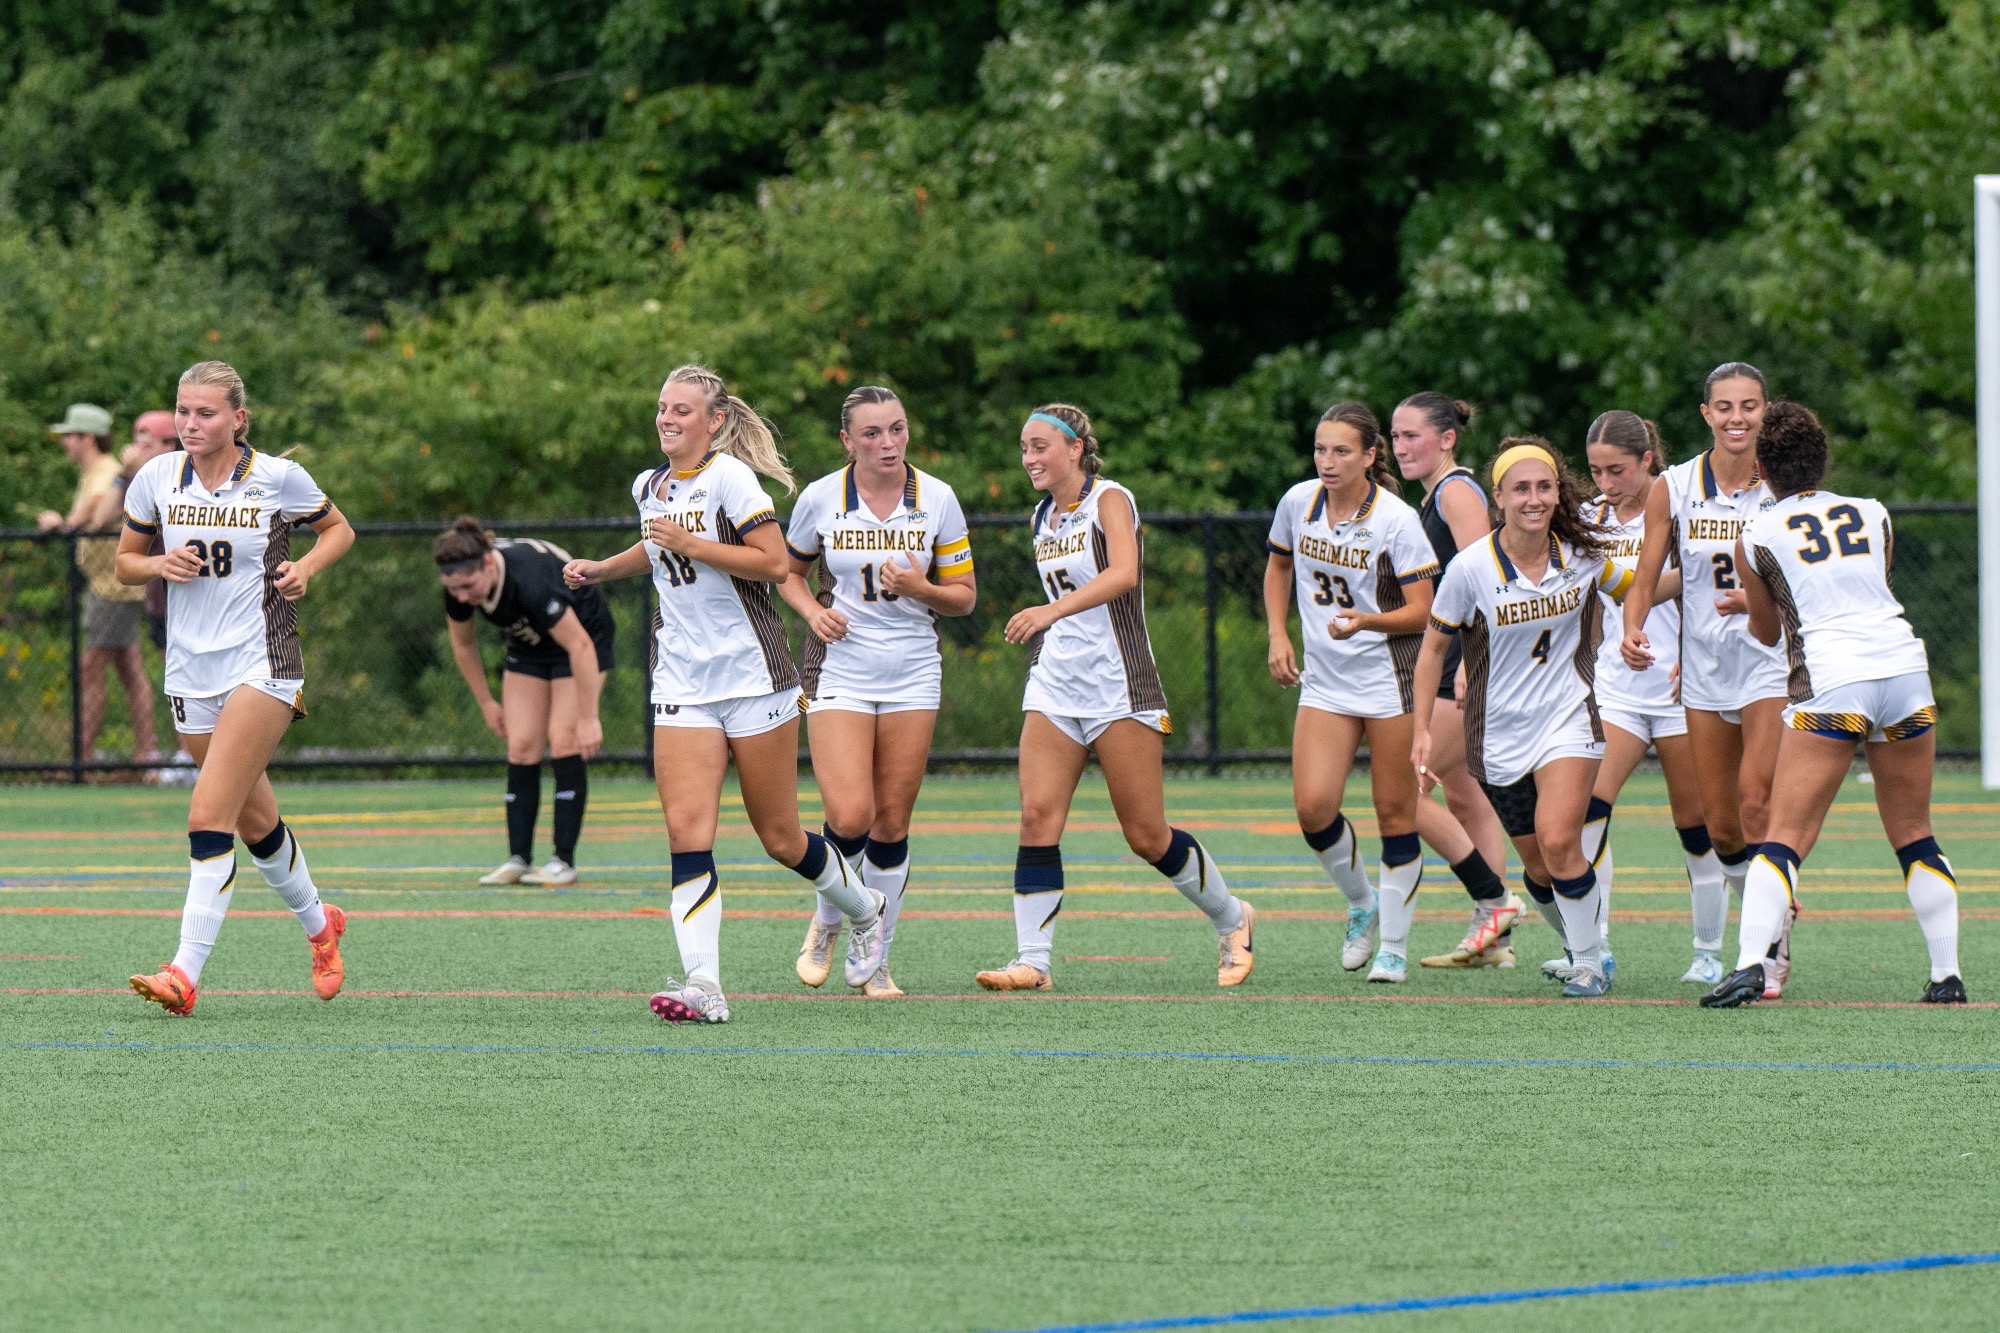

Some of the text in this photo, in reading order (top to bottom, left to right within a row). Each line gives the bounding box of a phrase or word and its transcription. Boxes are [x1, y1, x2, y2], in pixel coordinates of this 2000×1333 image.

[244, 489, 265, 499] MAAC
[689, 490, 707, 503] MAAC
[167, 504, 262, 528] MERRIMACK
[908, 511, 928, 524] MAAC
[832, 529, 926, 551] MERRIMACK
[1298, 533, 1371, 570] MERRIMACK
[1353, 530, 1374, 540] MAAC
[1786, 503, 1871, 565] 32
[185, 538, 233, 579] 28
[658, 548, 698, 588] 18
[1711, 551, 1744, 590] 2
[1046, 567, 1078, 601] 15
[1313, 569, 1356, 610] 33
[1496, 586, 1580, 626] MERRIMACK
[1530, 628, 1552, 664] 4
[167, 695, 187, 724] 8
